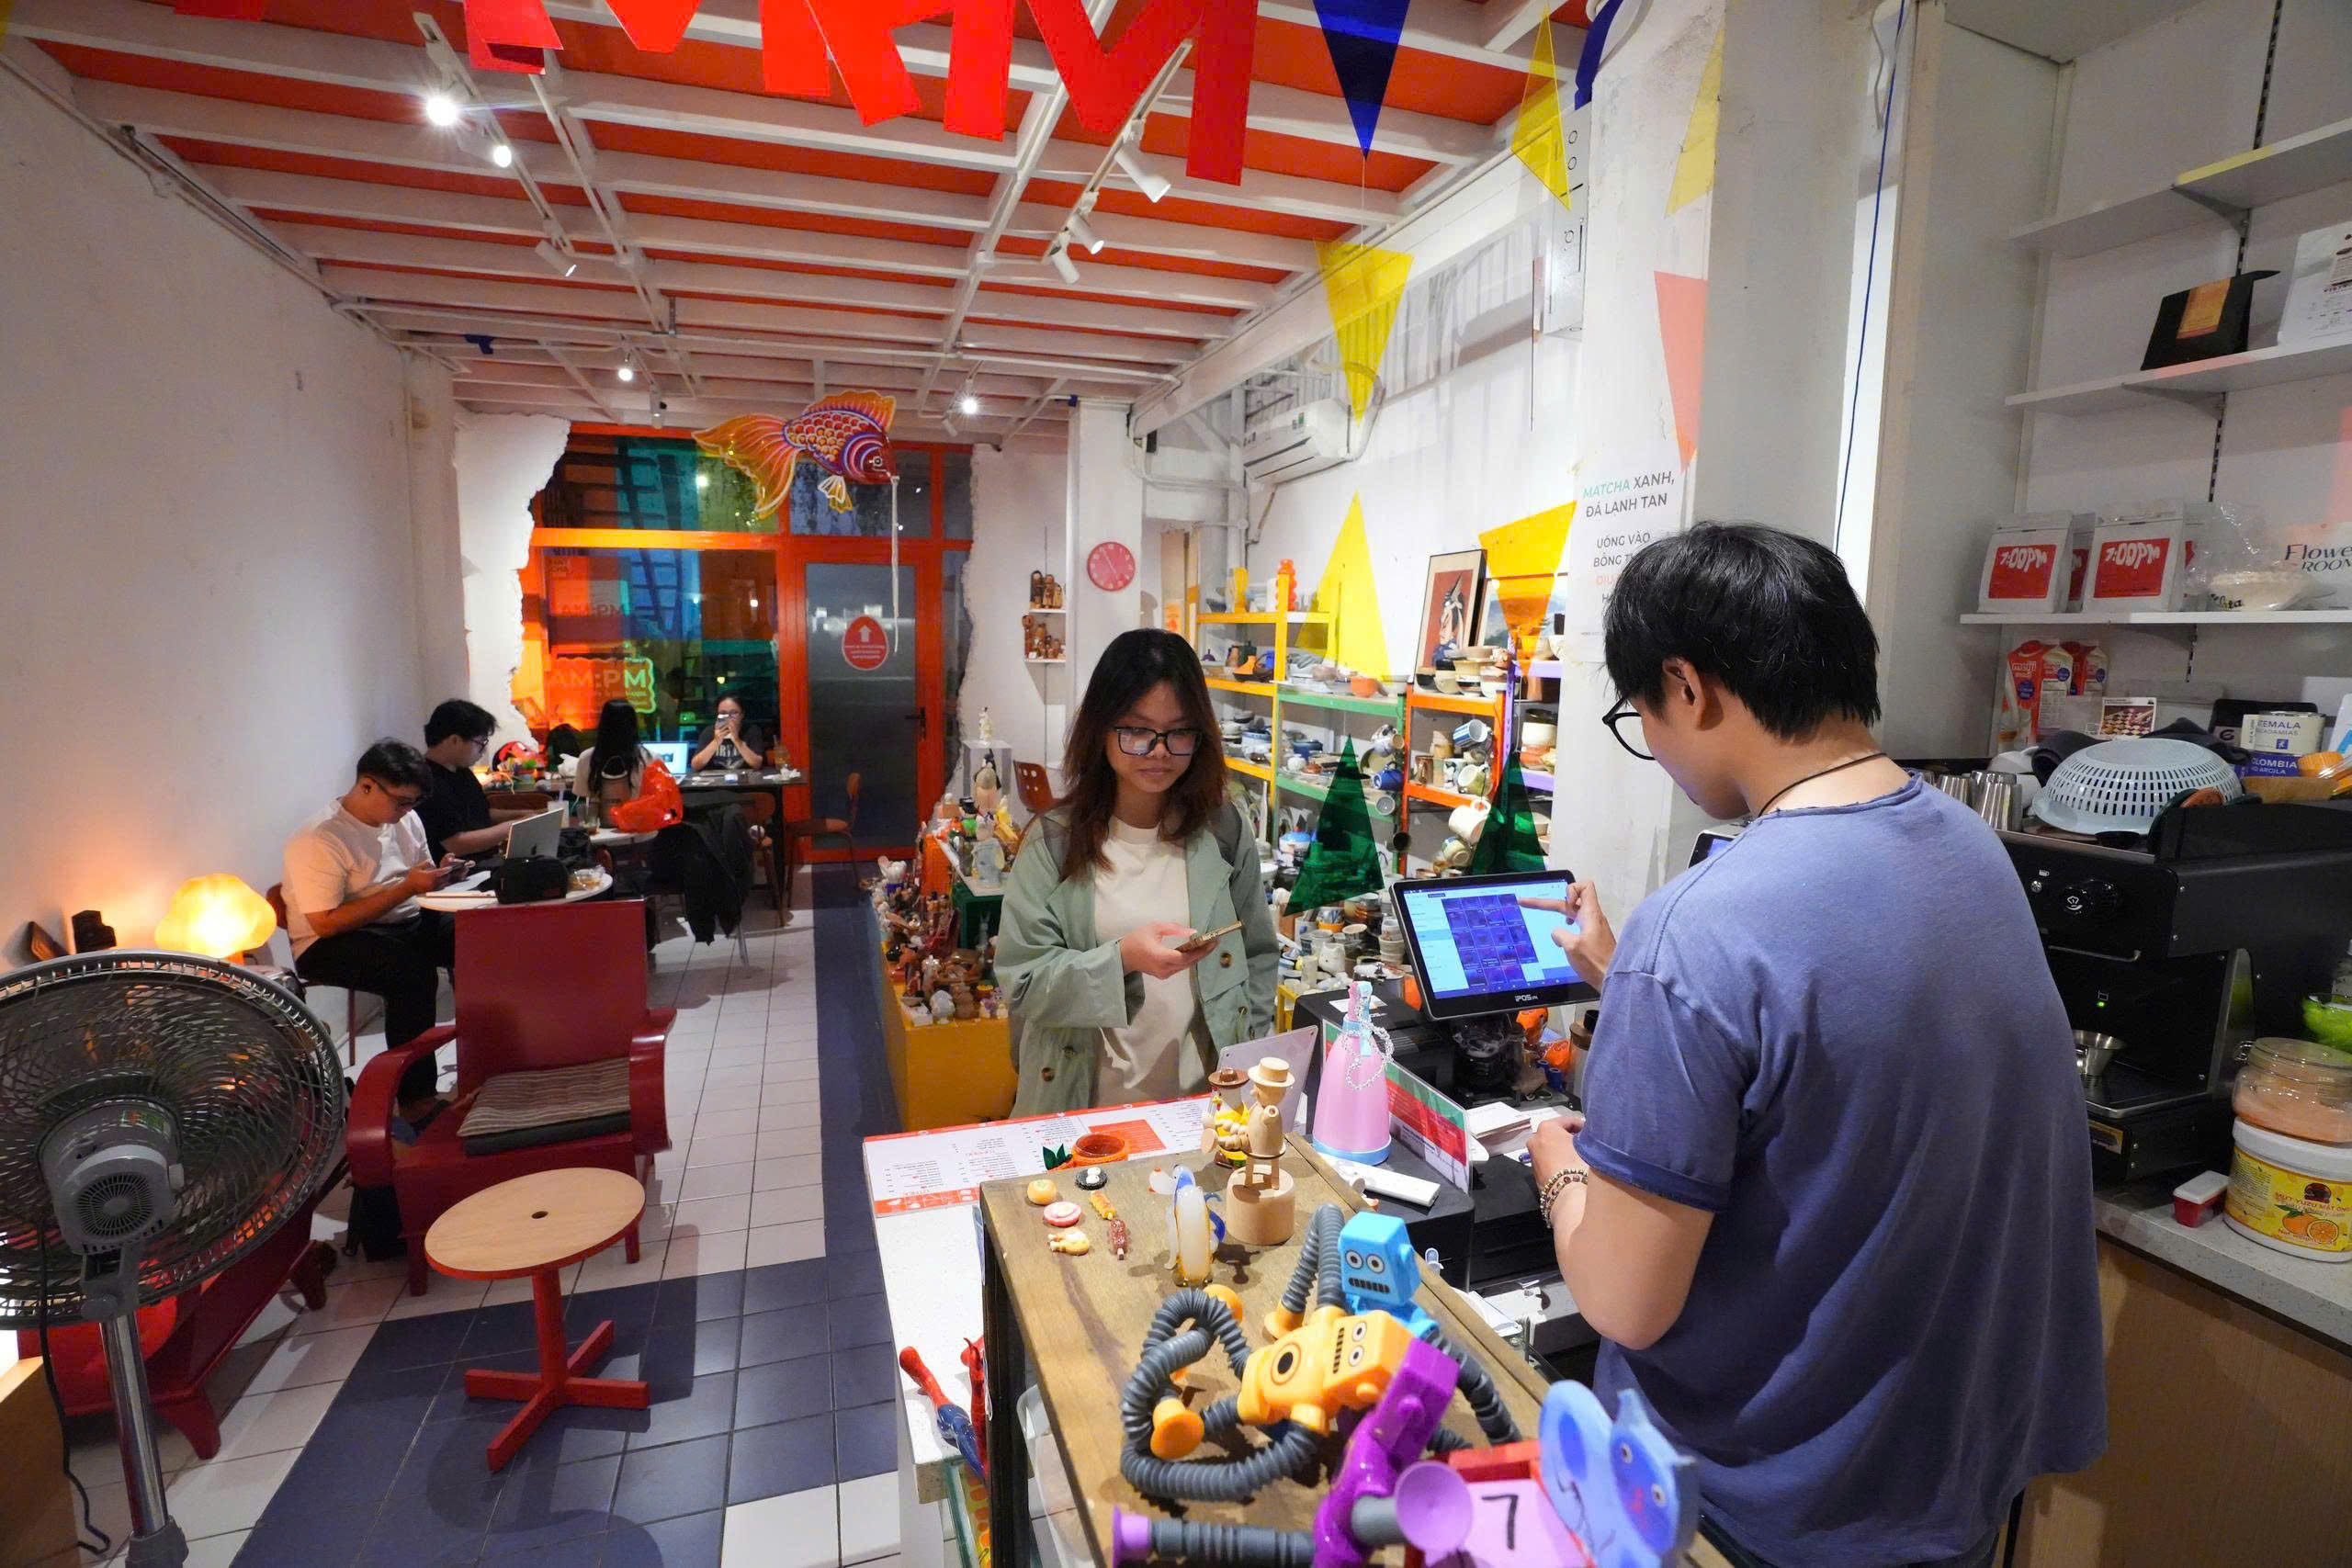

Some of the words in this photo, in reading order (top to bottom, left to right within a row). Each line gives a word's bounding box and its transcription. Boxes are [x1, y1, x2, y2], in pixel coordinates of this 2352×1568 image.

[1583, 479, 1631, 498] MATCHA
[1633, 470, 1675, 490] XANH,
[1586, 501, 1601, 518] ĐÁ
[1604, 498, 1637, 516] LẠNH
[1640, 492, 1668, 509] TAN
[1481, 1493, 1520, 1551] 7
